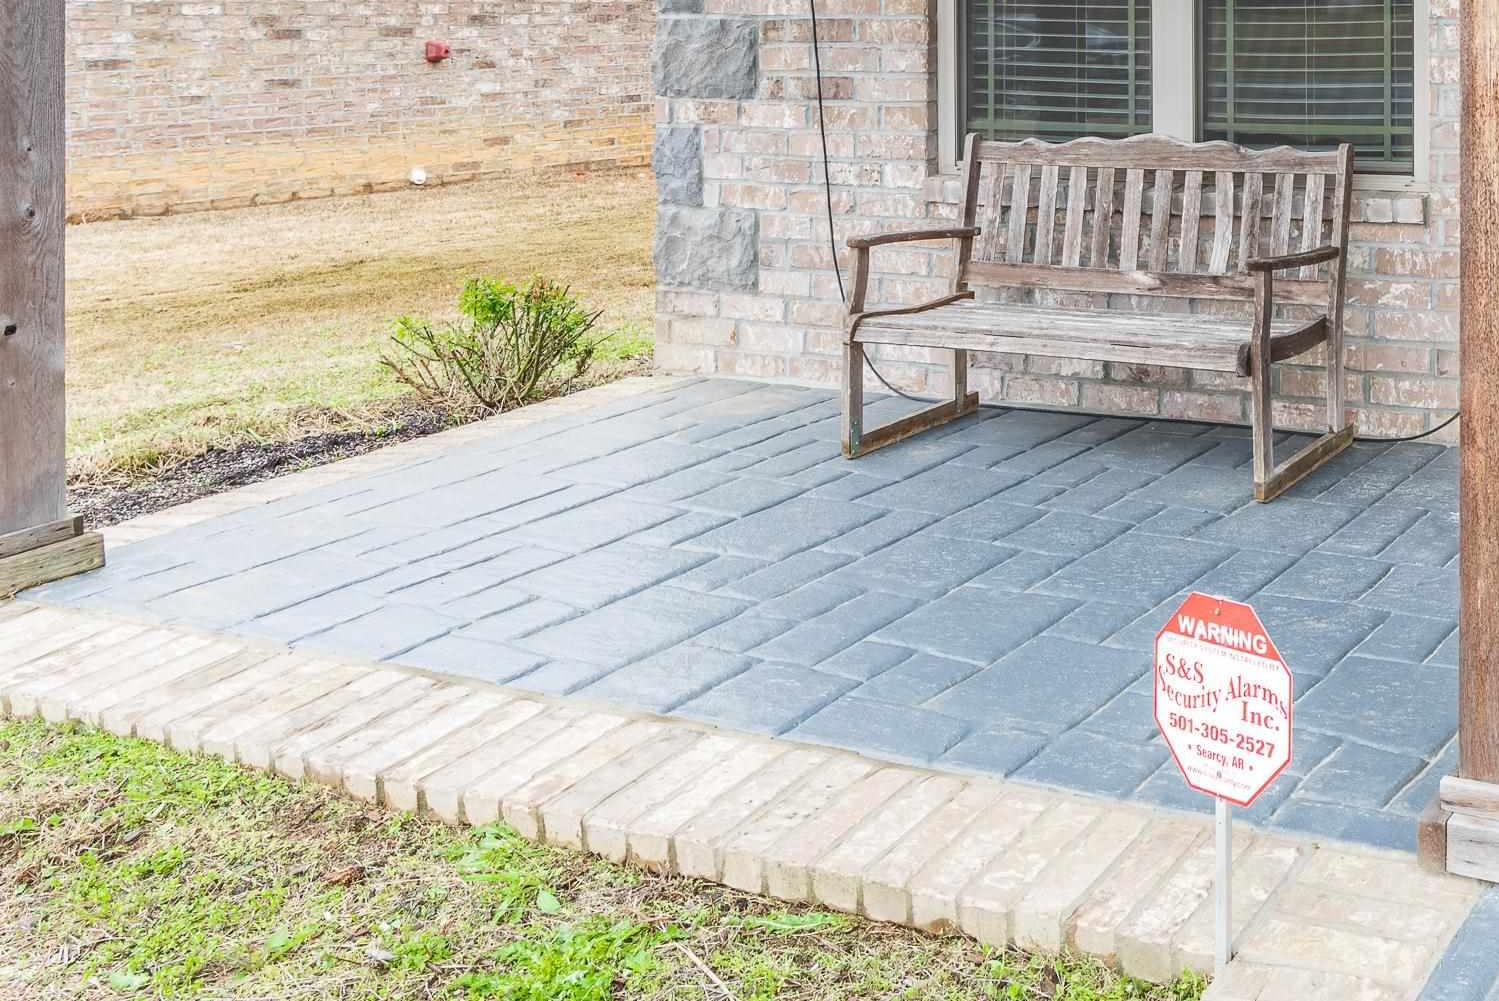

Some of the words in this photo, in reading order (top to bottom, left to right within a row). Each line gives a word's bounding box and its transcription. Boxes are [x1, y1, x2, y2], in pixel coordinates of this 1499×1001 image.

[1177, 613, 1267, 655] WARNING
[1165, 653, 1204, 684] S&S
[1158, 665, 1222, 713] Security
[1241, 700, 1280, 732] Inc.
[1169, 712, 1275, 759] 501-305-2527
[1231, 756, 1245, 770] AR
